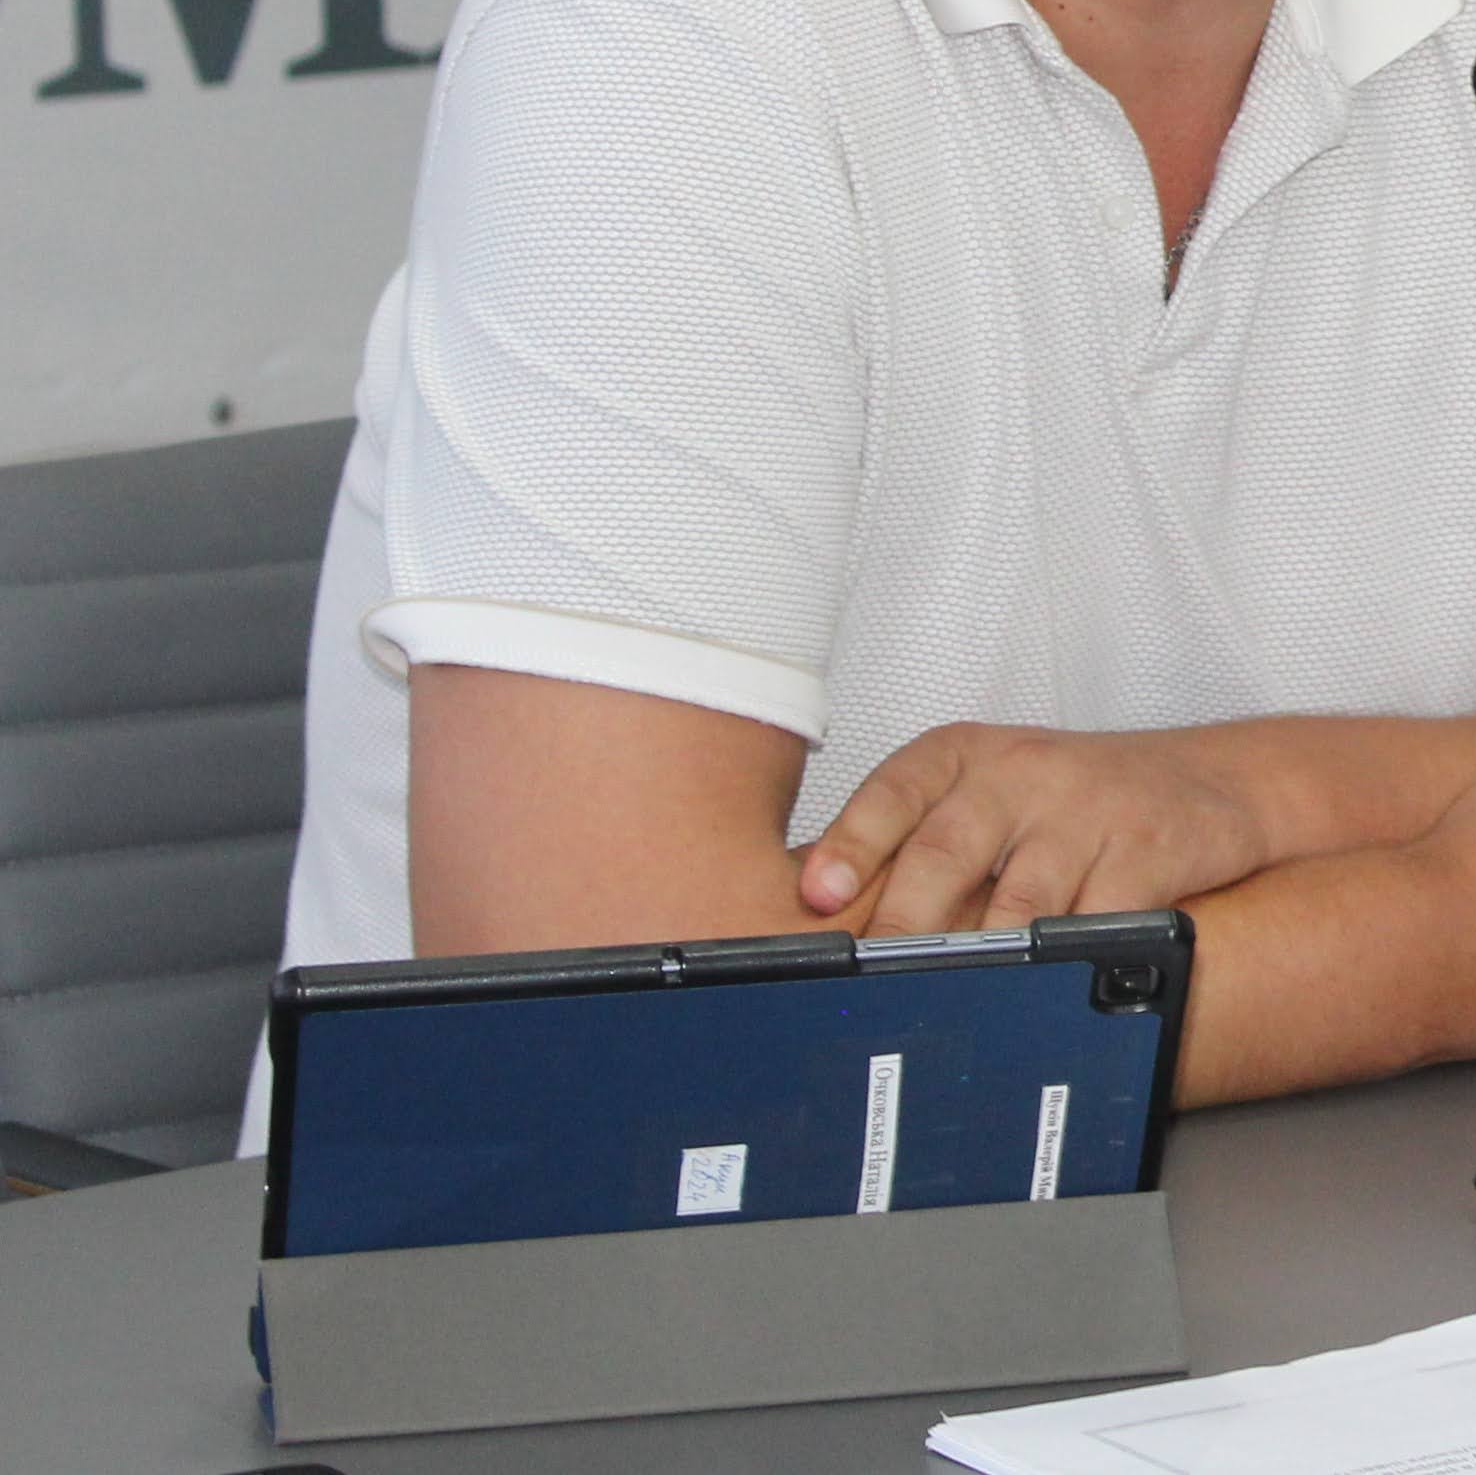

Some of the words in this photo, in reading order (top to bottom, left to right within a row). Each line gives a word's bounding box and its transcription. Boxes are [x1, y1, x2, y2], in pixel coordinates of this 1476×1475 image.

[870, 1067, 896, 1148] Очковська
[1038, 1130, 1059, 1172] Валерій
[685, 1158, 712, 1202] 2024
[863, 1151, 888, 1207] Наталія
